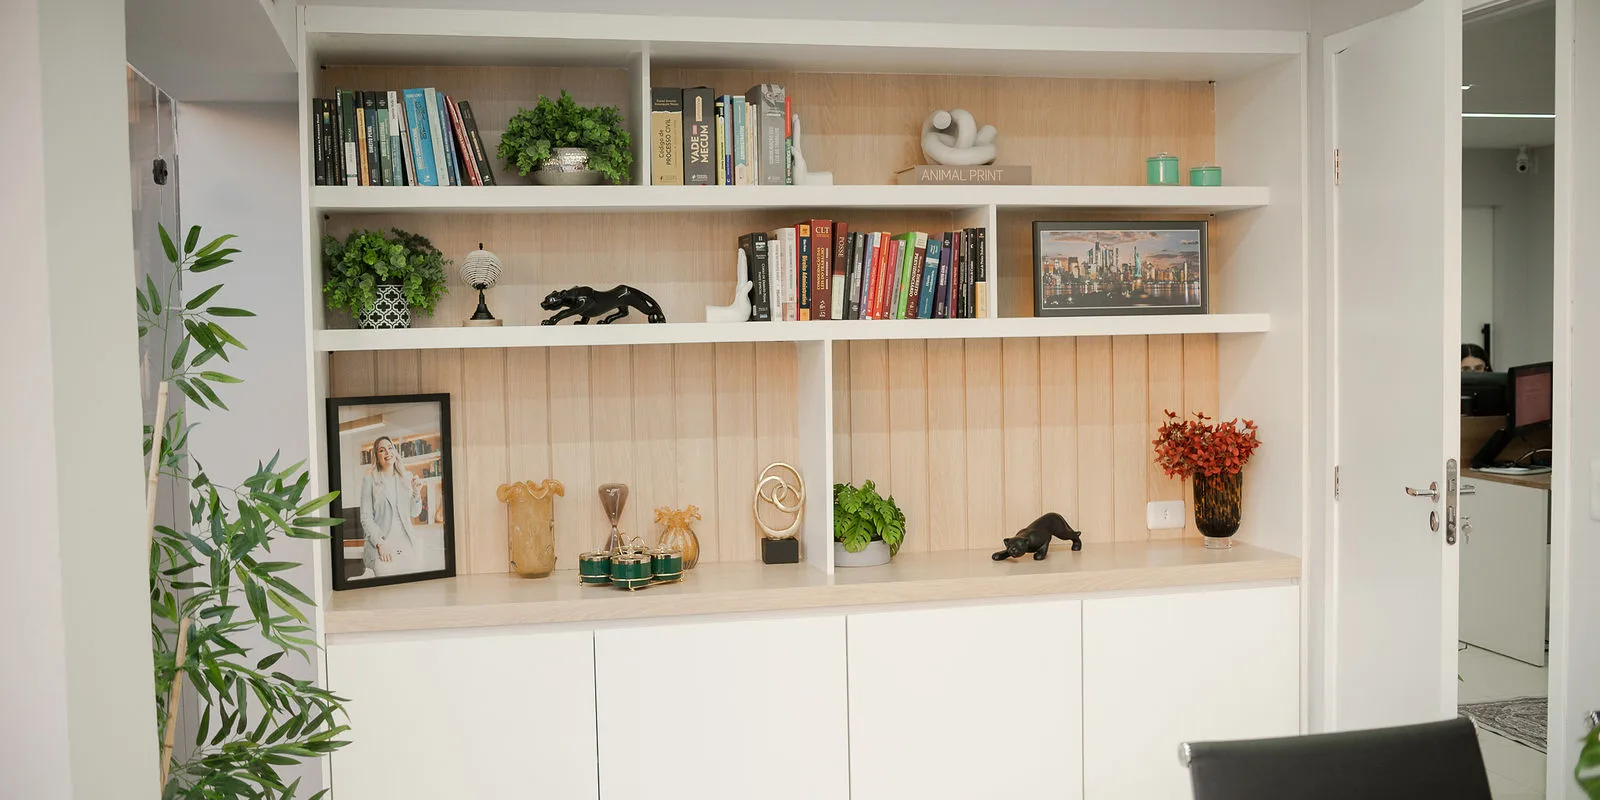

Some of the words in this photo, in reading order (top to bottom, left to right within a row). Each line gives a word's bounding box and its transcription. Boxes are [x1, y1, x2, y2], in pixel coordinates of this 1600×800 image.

[659, 129, 664, 137] de
[691, 136, 699, 164] VADE
[700, 125, 709, 163] MECUM
[921, 169, 967, 181] ANIMAL
[969, 169, 1004, 181] PRINT
[815, 226, 830, 234] CLT
[909, 252, 919, 297] PREVIDENCIÁRIO
